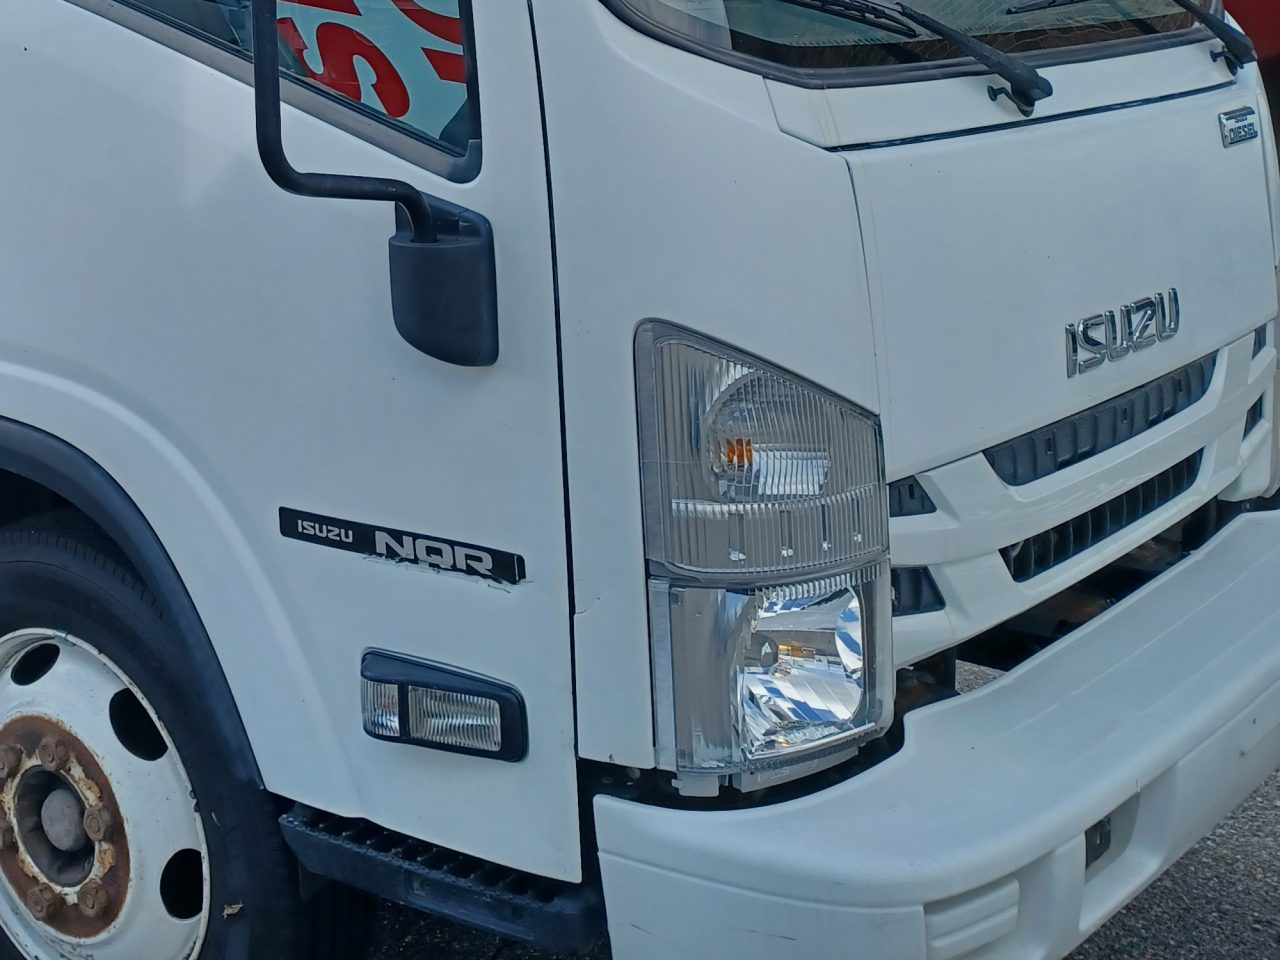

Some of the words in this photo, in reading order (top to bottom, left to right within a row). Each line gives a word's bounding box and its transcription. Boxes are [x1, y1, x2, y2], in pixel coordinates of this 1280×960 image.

[1064, 287, 1180, 379] ISUZU
[297, 519, 353, 543] ISUZU
[374, 530, 494, 576] NQR
